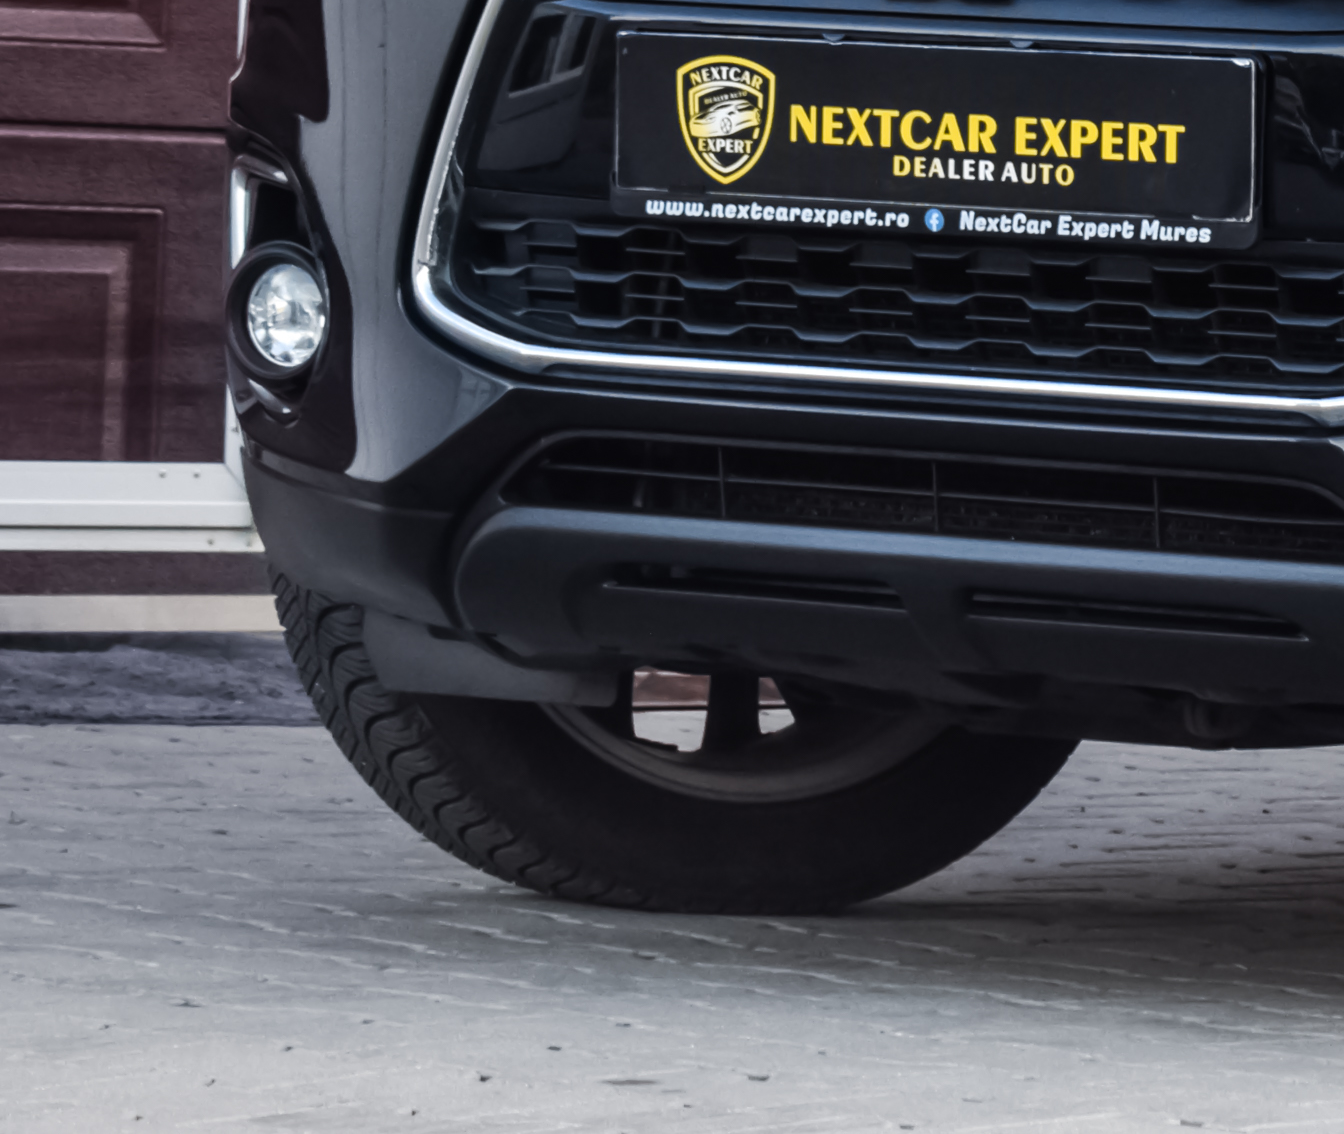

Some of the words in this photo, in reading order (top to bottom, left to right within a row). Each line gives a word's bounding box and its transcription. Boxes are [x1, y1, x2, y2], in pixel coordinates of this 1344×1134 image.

[689, 66, 763, 90] NEXTCAR
[698, 138, 753, 154] EXPERT
[790, 104, 998, 154] NEXTCAR
[1015, 116, 1186, 164] EXPERT
[893, 155, 995, 183] DEALER
[1001, 161, 1075, 186] AUTO
[645, 199, 910, 228] www.nextcarexpert.ro
[959, 210, 1052, 235] NextCar
[1057, 215, 1135, 241] Expert
[1140, 219, 1212, 244] Mures
